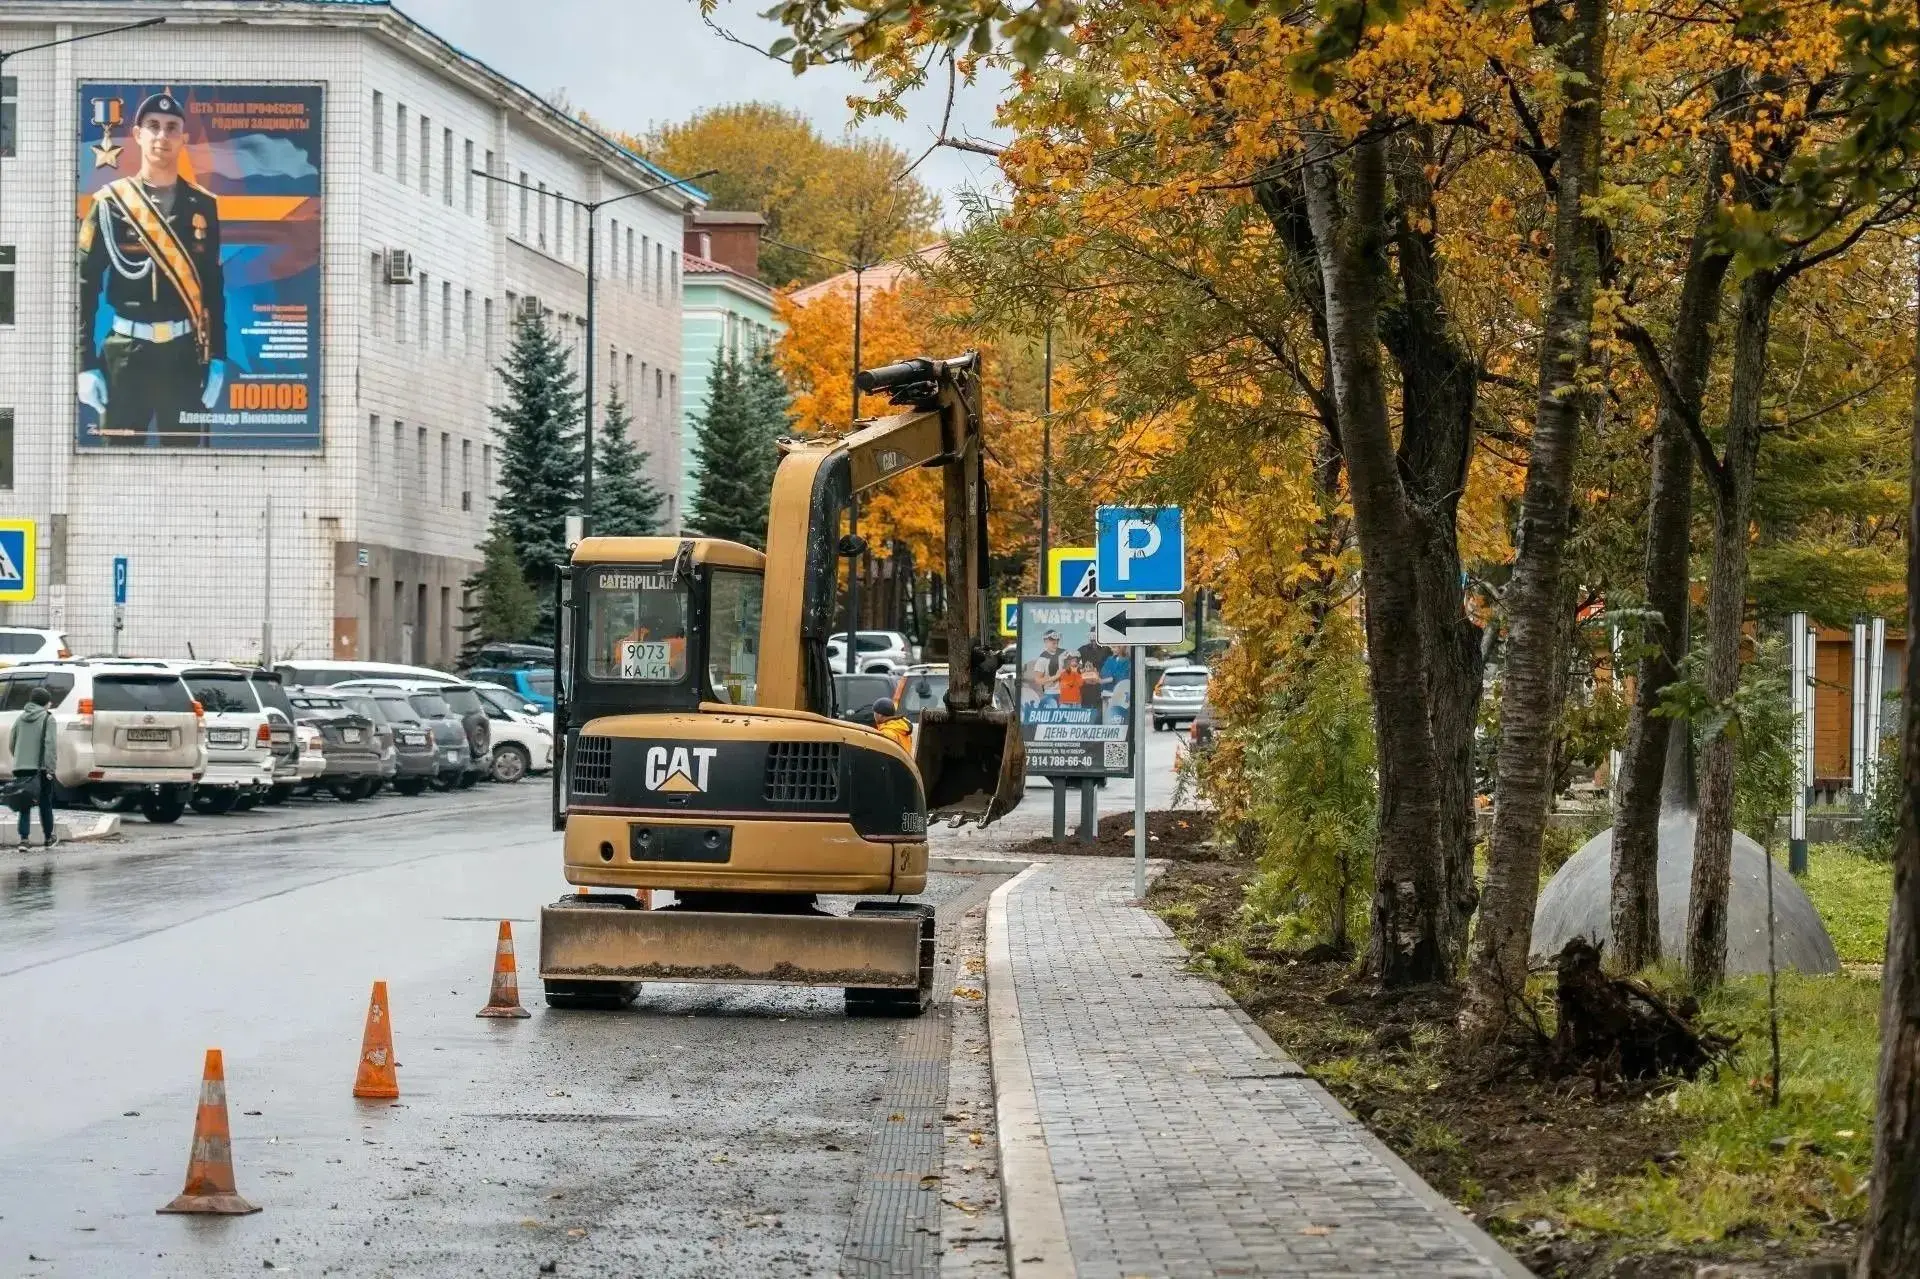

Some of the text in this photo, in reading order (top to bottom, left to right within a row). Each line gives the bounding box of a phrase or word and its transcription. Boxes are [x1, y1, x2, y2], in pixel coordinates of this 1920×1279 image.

[229, 383, 308, 410] ПОПОВ
[179, 411, 308, 426] Александр Николаевич
[1117, 519, 1162, 581] P
[599, 574, 675, 590] CATERPILLAR
[1029, 608, 1097, 624] WARPO
[627, 645, 665, 660] 9073
[651, 664, 667, 677] 41
[1029, 708, 1092, 723] ВАШ ЛУЧШИЙ
[1043, 727, 1121, 740] ДЕНЬ РОЖДЕНИЯ
[1031, 755, 1048, 767] 914
[1050, 755, 1092, 767] 788-66-40
[645, 745, 717, 793] CAT
